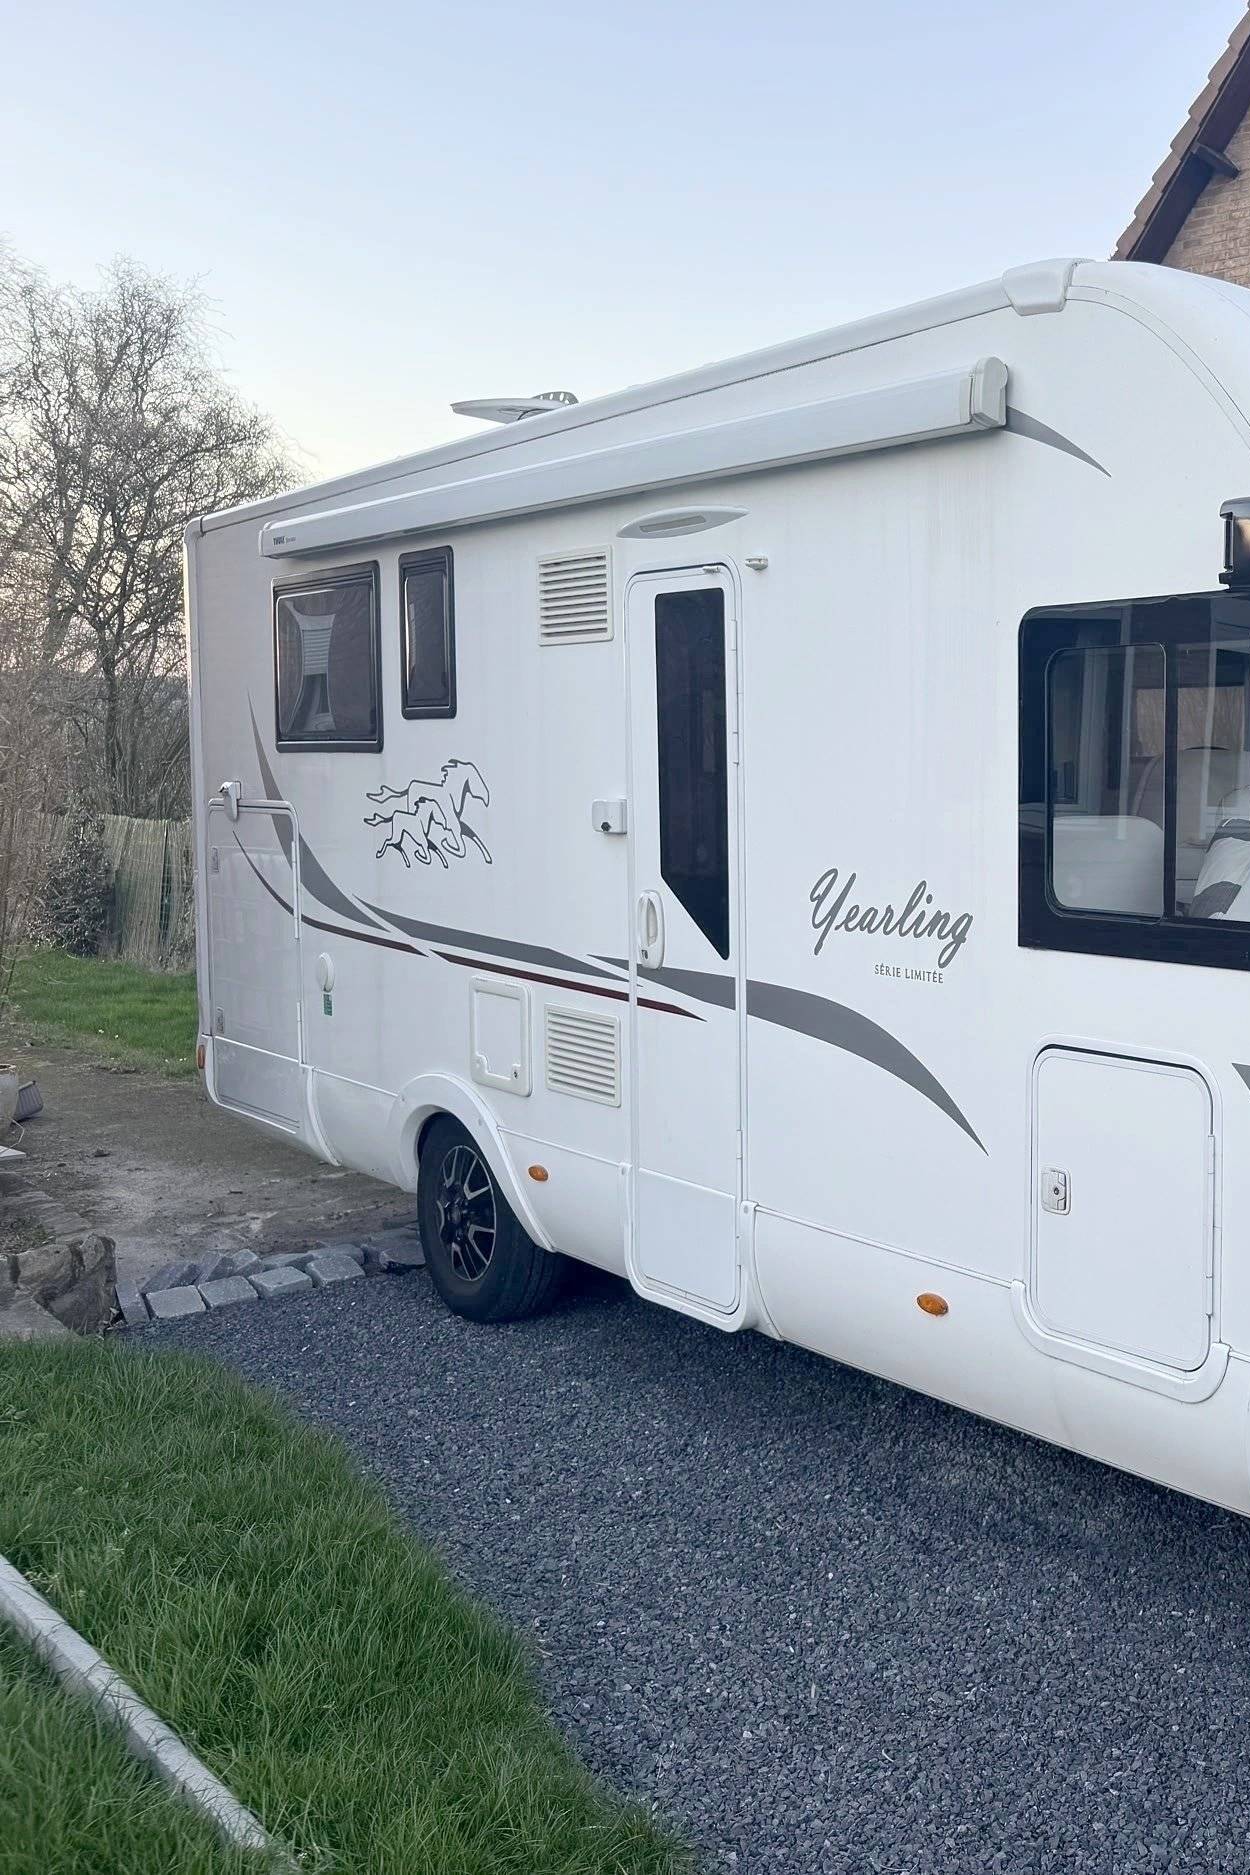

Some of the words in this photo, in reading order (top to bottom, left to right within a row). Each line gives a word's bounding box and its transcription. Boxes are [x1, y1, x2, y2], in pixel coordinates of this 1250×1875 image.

[810, 868, 973, 969] Yearling
[874, 963, 901, 978] SÉRIE
[904, 968, 944, 984] LIMITÉE
